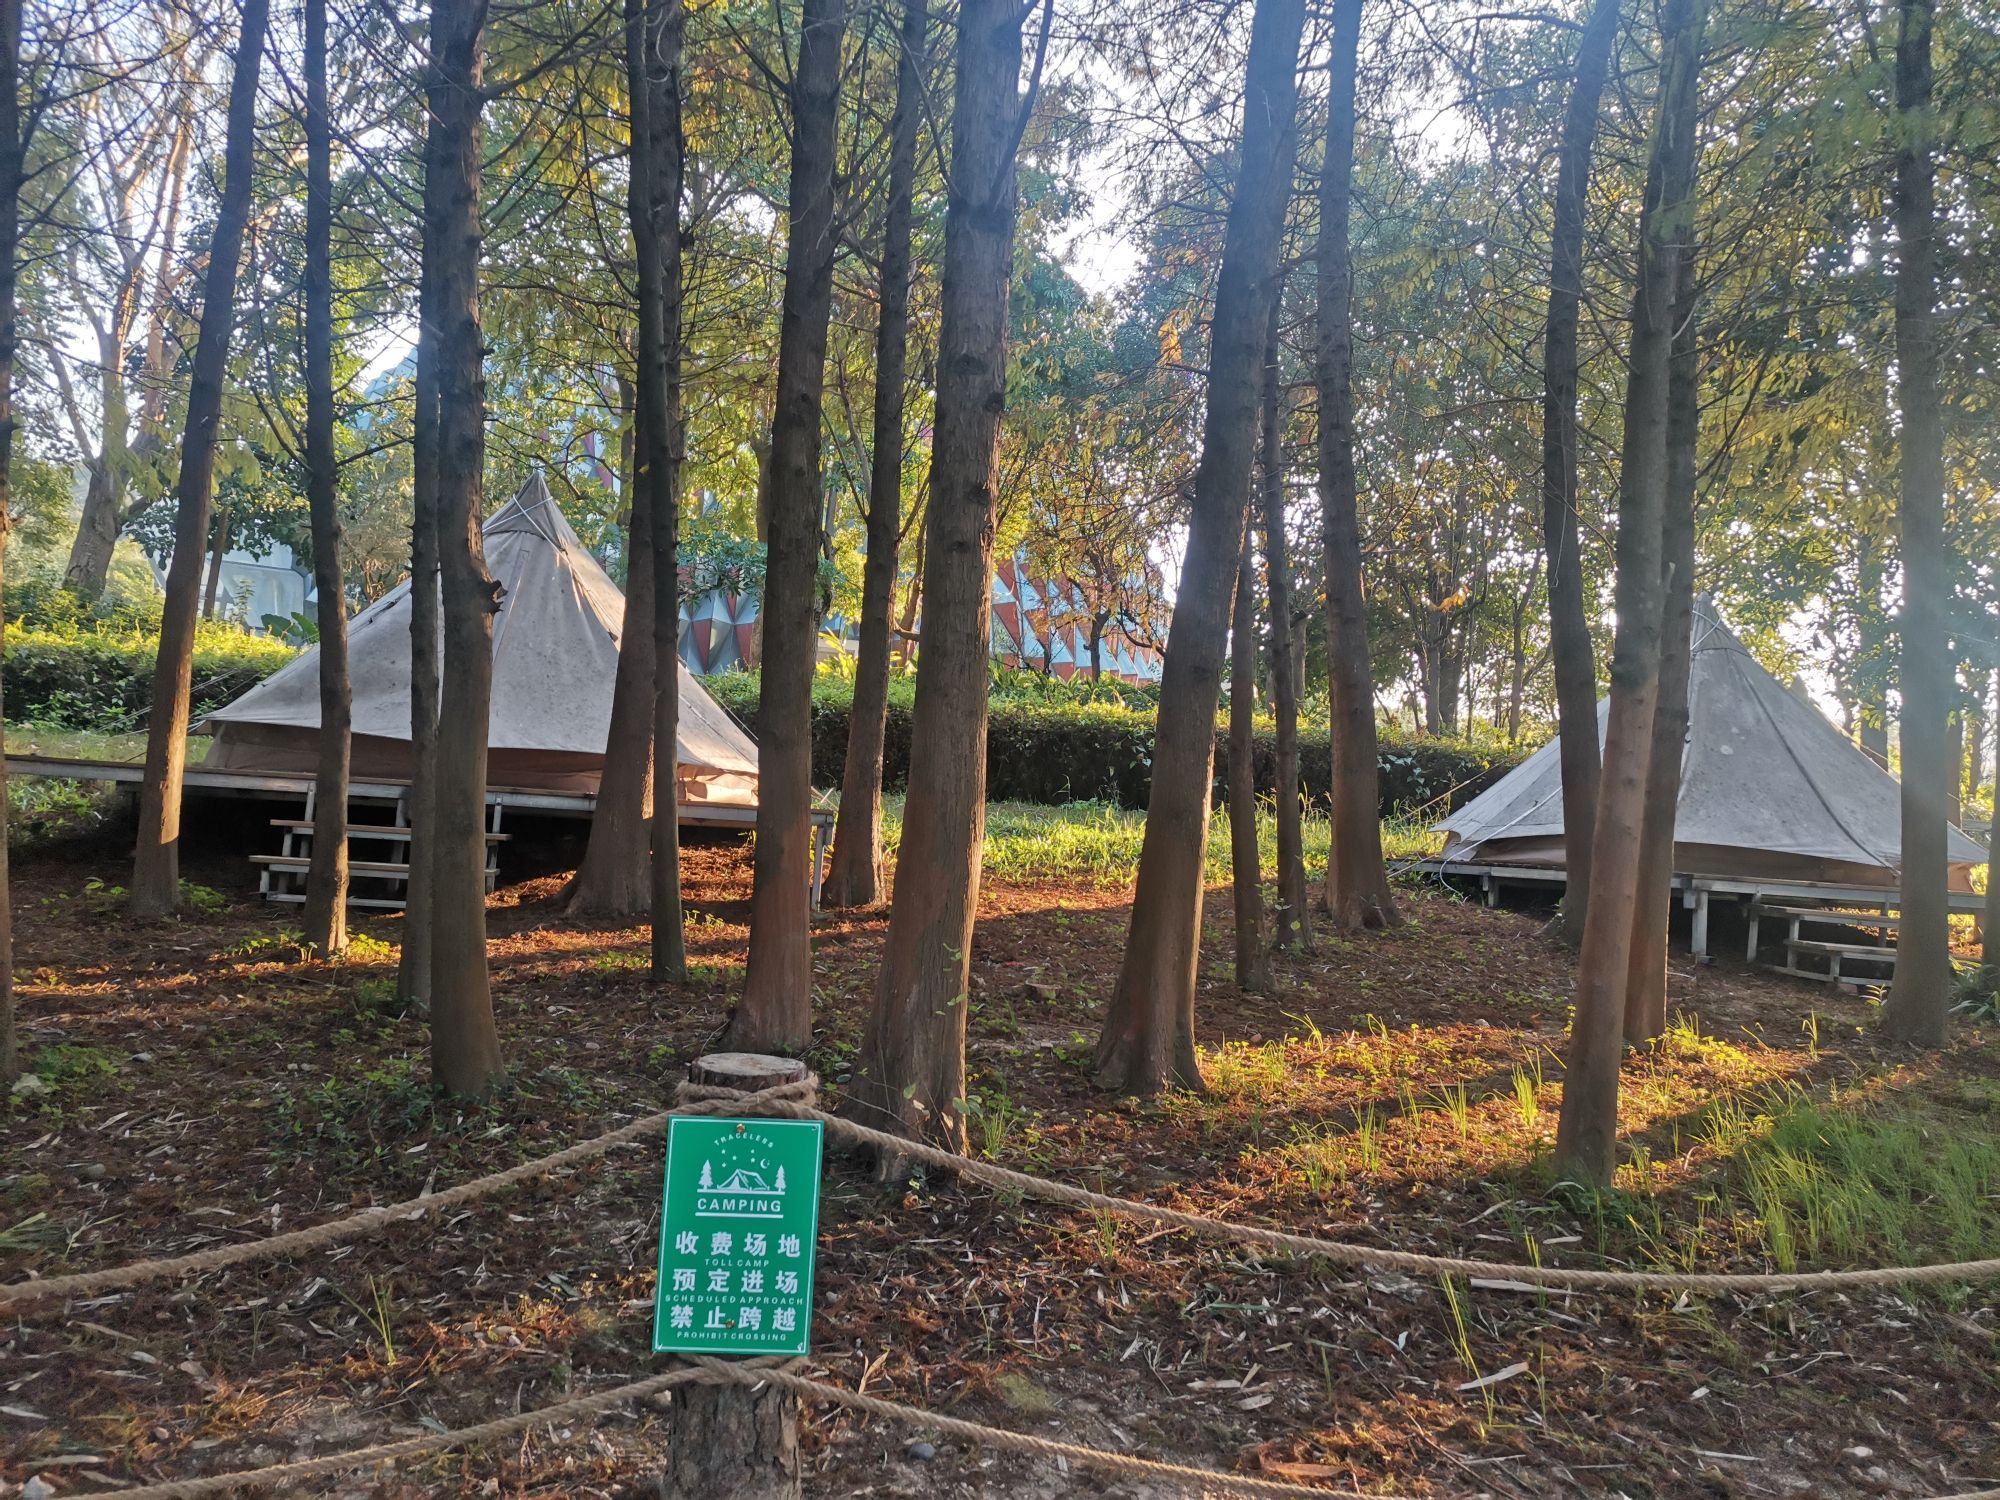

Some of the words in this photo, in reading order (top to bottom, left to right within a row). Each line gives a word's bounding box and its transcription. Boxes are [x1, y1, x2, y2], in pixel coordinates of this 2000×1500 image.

[697, 1198, 781, 1212] CAMPING
[675, 1231, 800, 1257] 收费场地
[704, 1258, 733, 1267] TOLL
[737, 1259, 769, 1268] CAMP
[672, 1268, 798, 1294] 预定进场
[665, 1295, 736, 1303] SCHEDULED
[740, 1296, 803, 1305] APPROACH
[670, 1304, 796, 1331] 禁止跨越
[677, 1331, 728, 1340] PROHIBIT
[731, 1333, 786, 1341] CROSSING
